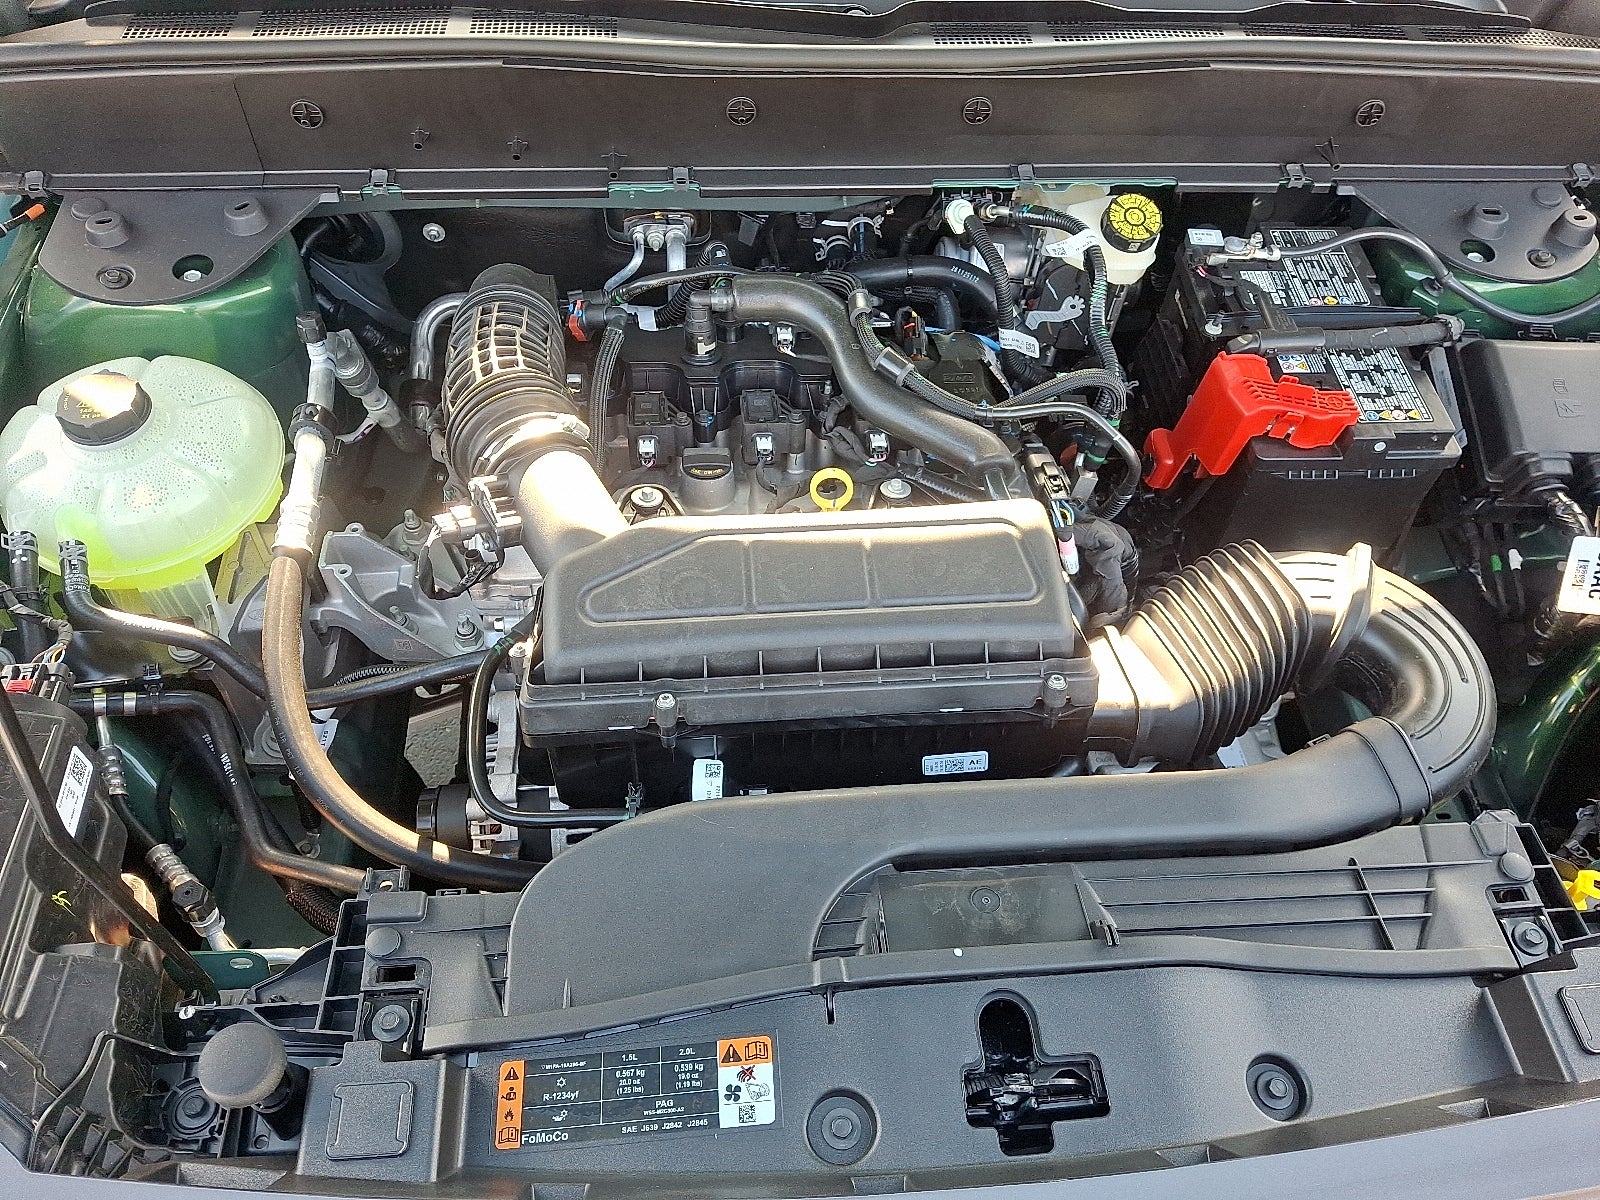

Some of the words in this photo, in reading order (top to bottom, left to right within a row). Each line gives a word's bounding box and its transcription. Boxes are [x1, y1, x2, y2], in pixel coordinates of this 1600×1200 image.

[678, 1047, 696, 1056] 2.0L
[621, 1053, 638, 1062] 1.5L
[674, 1063, 693, 1073] 0.539
[694, 1062, 704, 1072] kg
[615, 1070, 635, 1079] 0.567
[636, 1069, 646, 1078] kg
[691, 1080, 702, 1088] lbs)
[632, 1085, 644, 1094] lbs)
[543, 1090, 579, 1101] R-1234yf
[655, 1099, 674, 1109] PAG
[621, 1125, 638, 1134] SAE
[640, 1124, 659, 1132] J639
[661, 1121, 683, 1130] J2842
[686, 1118, 708, 1128] J2845
[521, 1130, 569, 1145] FoMoCo
